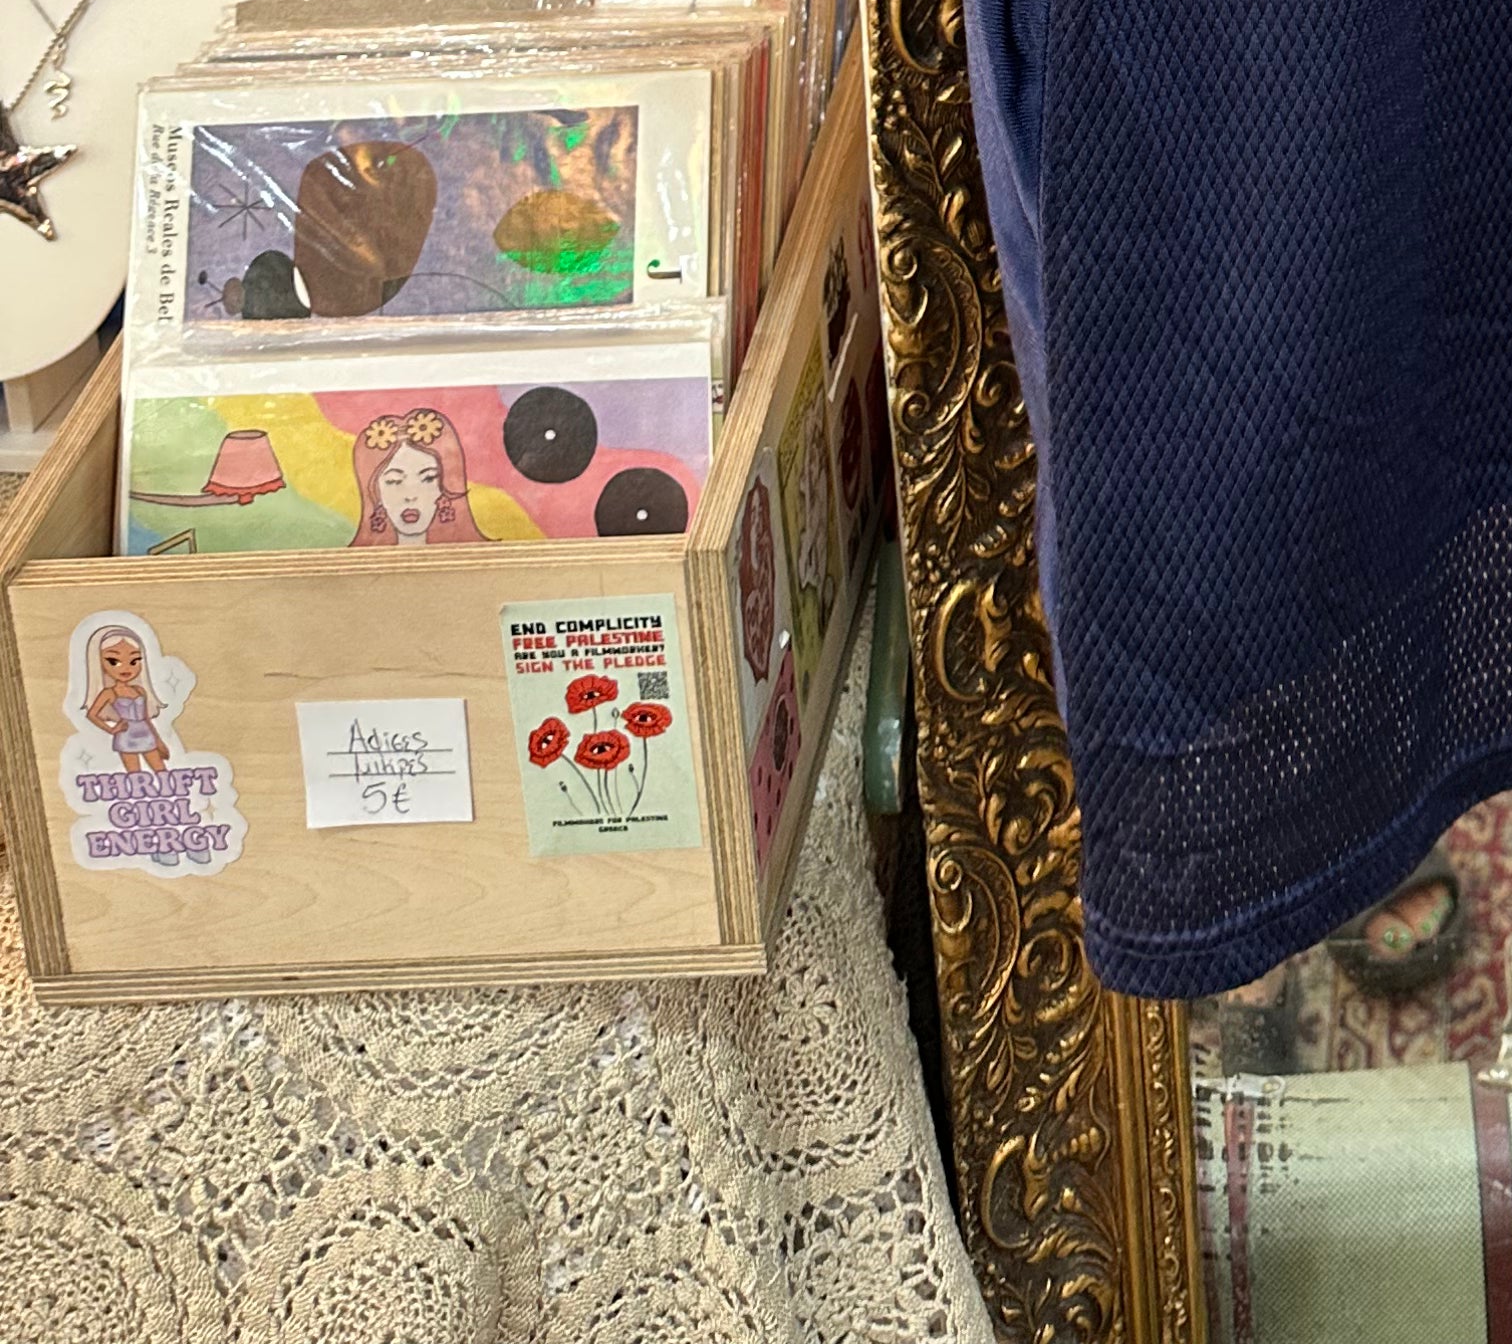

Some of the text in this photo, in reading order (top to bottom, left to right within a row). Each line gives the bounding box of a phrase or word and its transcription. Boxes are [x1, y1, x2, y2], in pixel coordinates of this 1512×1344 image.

[151, 124, 165, 149] Rue
[161, 198, 180, 258] Reales
[159, 263, 176, 286] de
[511, 616, 662, 635] END COMPLICITY
[512, 631, 664, 650] FREE PALESTINE
[514, 651, 536, 660] ARE
[542, 650, 565, 659] YOU
[571, 649, 578, 657] A
[516, 655, 666, 674] SIGN THE PLEDGE
[76, 767, 218, 802] THRIFT
[362, 782, 410, 814] 5€
[108, 798, 200, 828] GIRL
[86, 824, 230, 858] ENERGY
